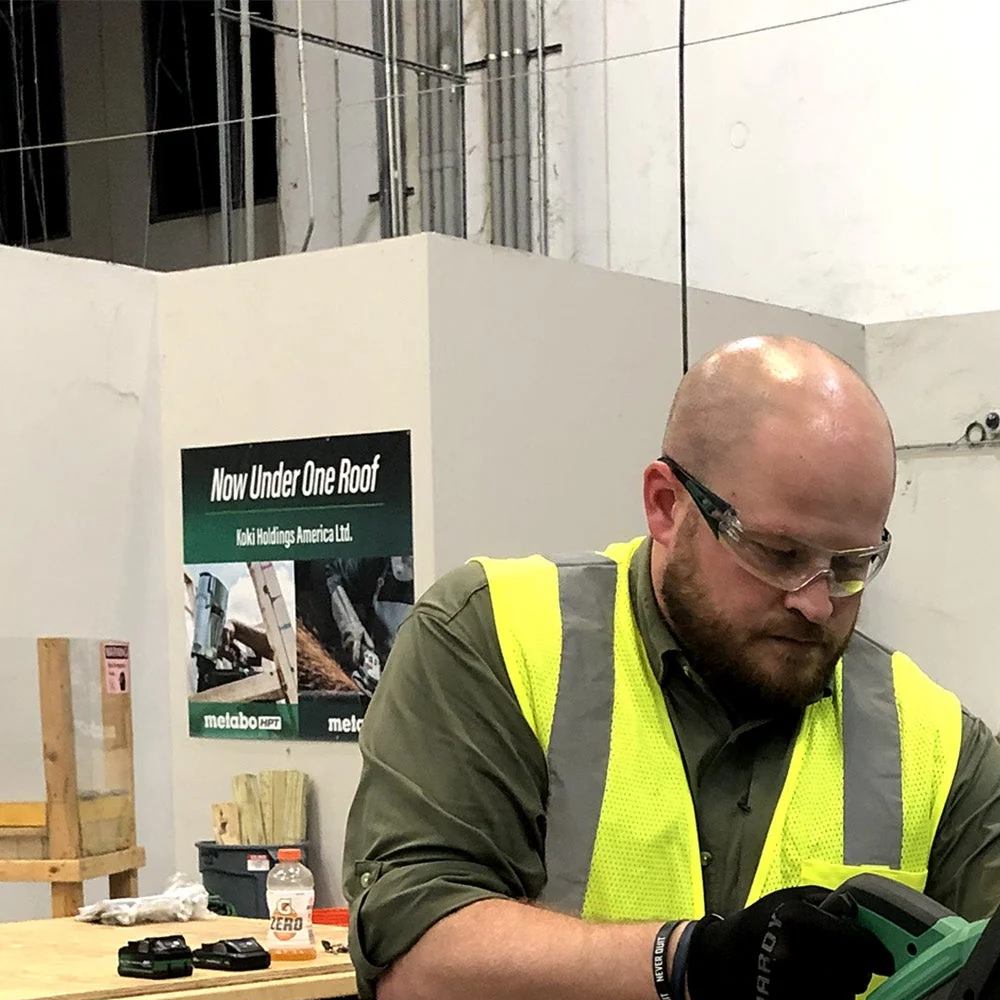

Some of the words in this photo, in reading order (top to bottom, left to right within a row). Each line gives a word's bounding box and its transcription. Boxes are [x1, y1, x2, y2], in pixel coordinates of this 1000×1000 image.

[210, 467, 248, 502] Now
[250, 461, 301, 500] Under
[302, 460, 336, 497] One
[337, 454, 381, 494] Roof
[236, 527, 256, 546] Koki
[257, 526, 296, 549] Holdings
[296, 524, 334, 545] America
[335, 523, 353, 543] Ltd.
[270, 916, 303, 931] ZERO
[654, 936, 666, 956] QUIT
[654, 955, 664, 982] NEVER
